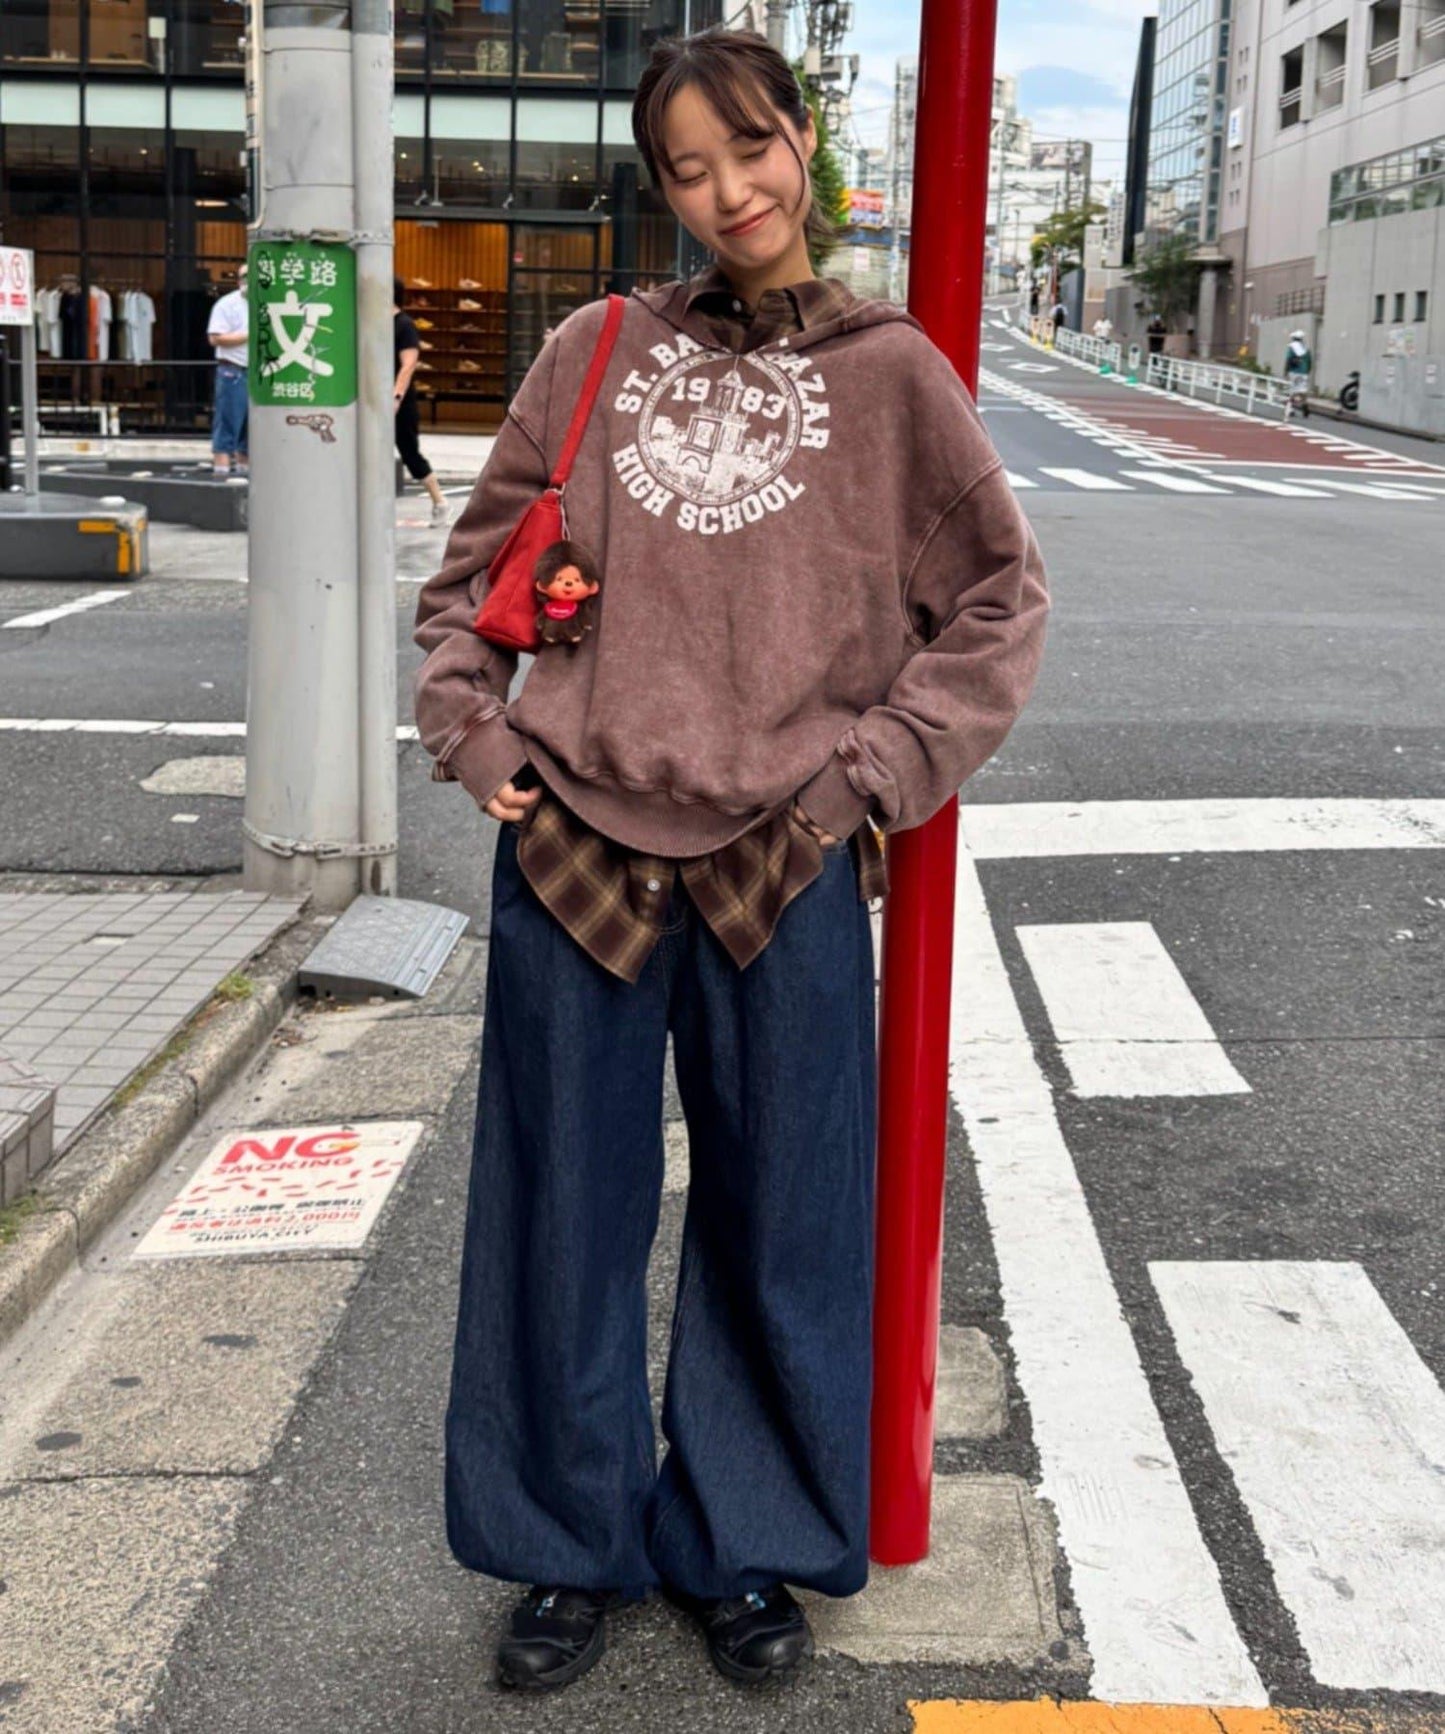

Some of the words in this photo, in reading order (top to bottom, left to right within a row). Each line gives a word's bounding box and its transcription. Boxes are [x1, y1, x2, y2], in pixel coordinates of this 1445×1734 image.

[261, 290, 334, 377] 文
[614, 370, 659, 414] ST.
[612, 443, 676, 517] HIGH
[677, 475, 806, 535] SCHOOL
